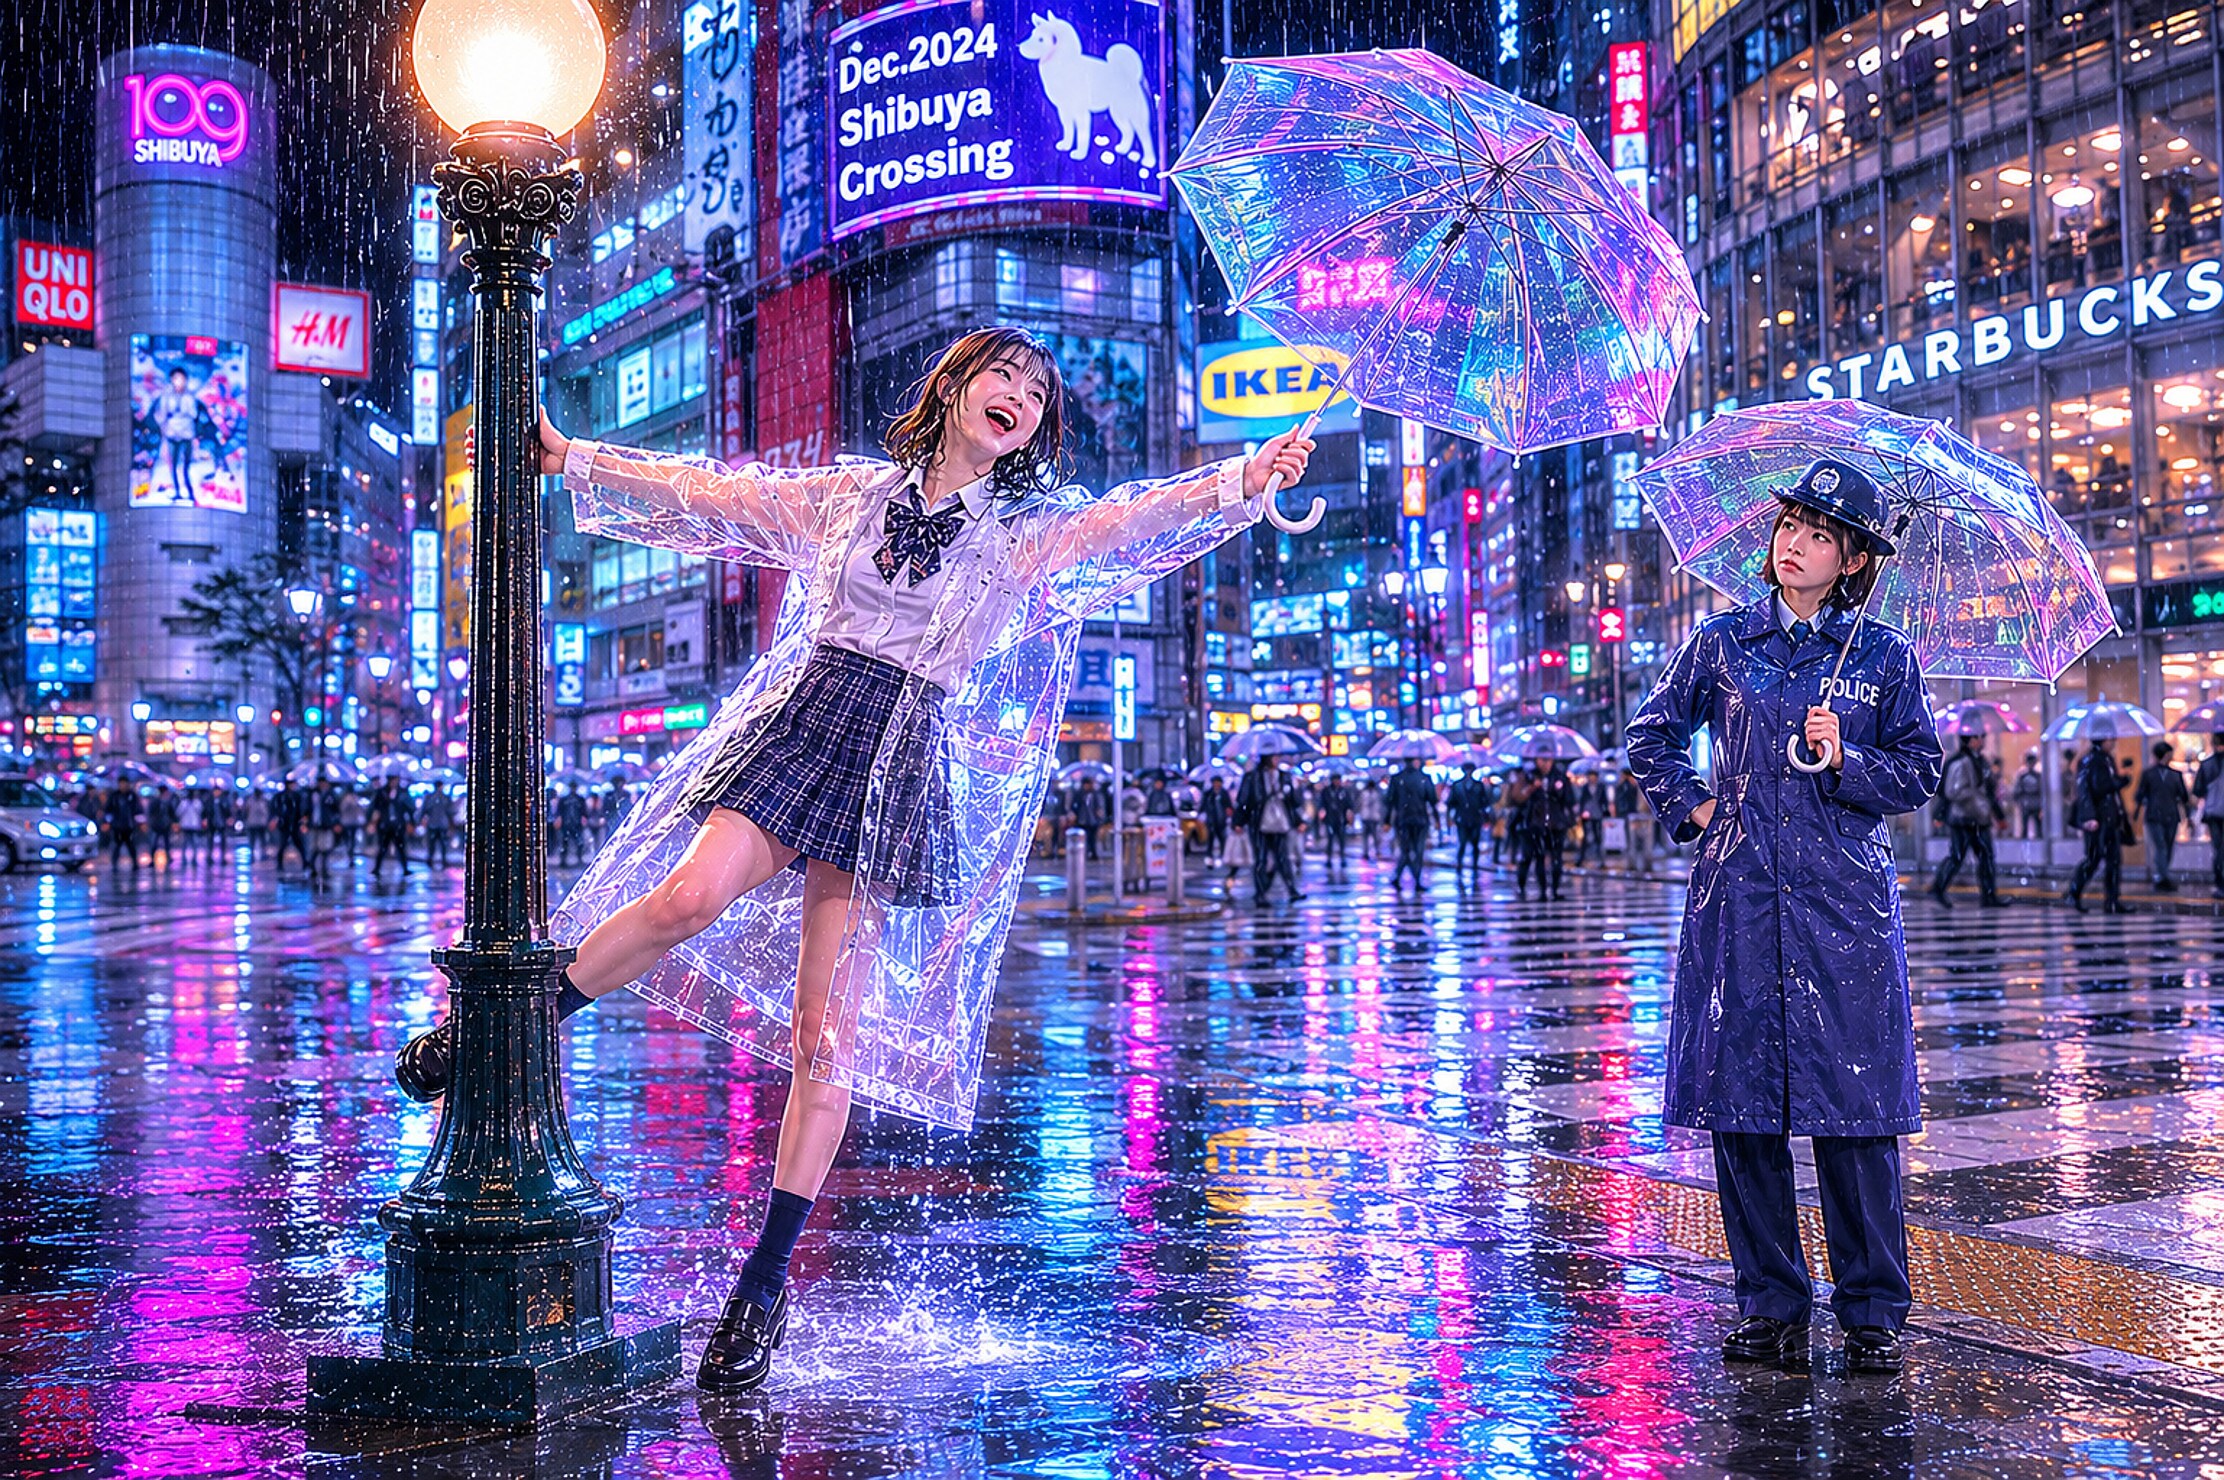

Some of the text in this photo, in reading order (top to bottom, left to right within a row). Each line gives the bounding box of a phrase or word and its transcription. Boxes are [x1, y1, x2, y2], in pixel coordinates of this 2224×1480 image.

[839, 22, 998, 95] Dec.2024
[124, 73, 249, 162] 109
[838, 87, 993, 147] Shibuya
[134, 138, 223, 167] SHIBUYA
[838, 136, 1015, 202] Crossing
[24, 247, 87, 288] UNI
[23, 282, 89, 322] QLO
[1806, 260, 2224, 401] STARBUCKS
[1212, 362, 1340, 400] IKEA
[1819, 677, 1880, 707] POLICE
